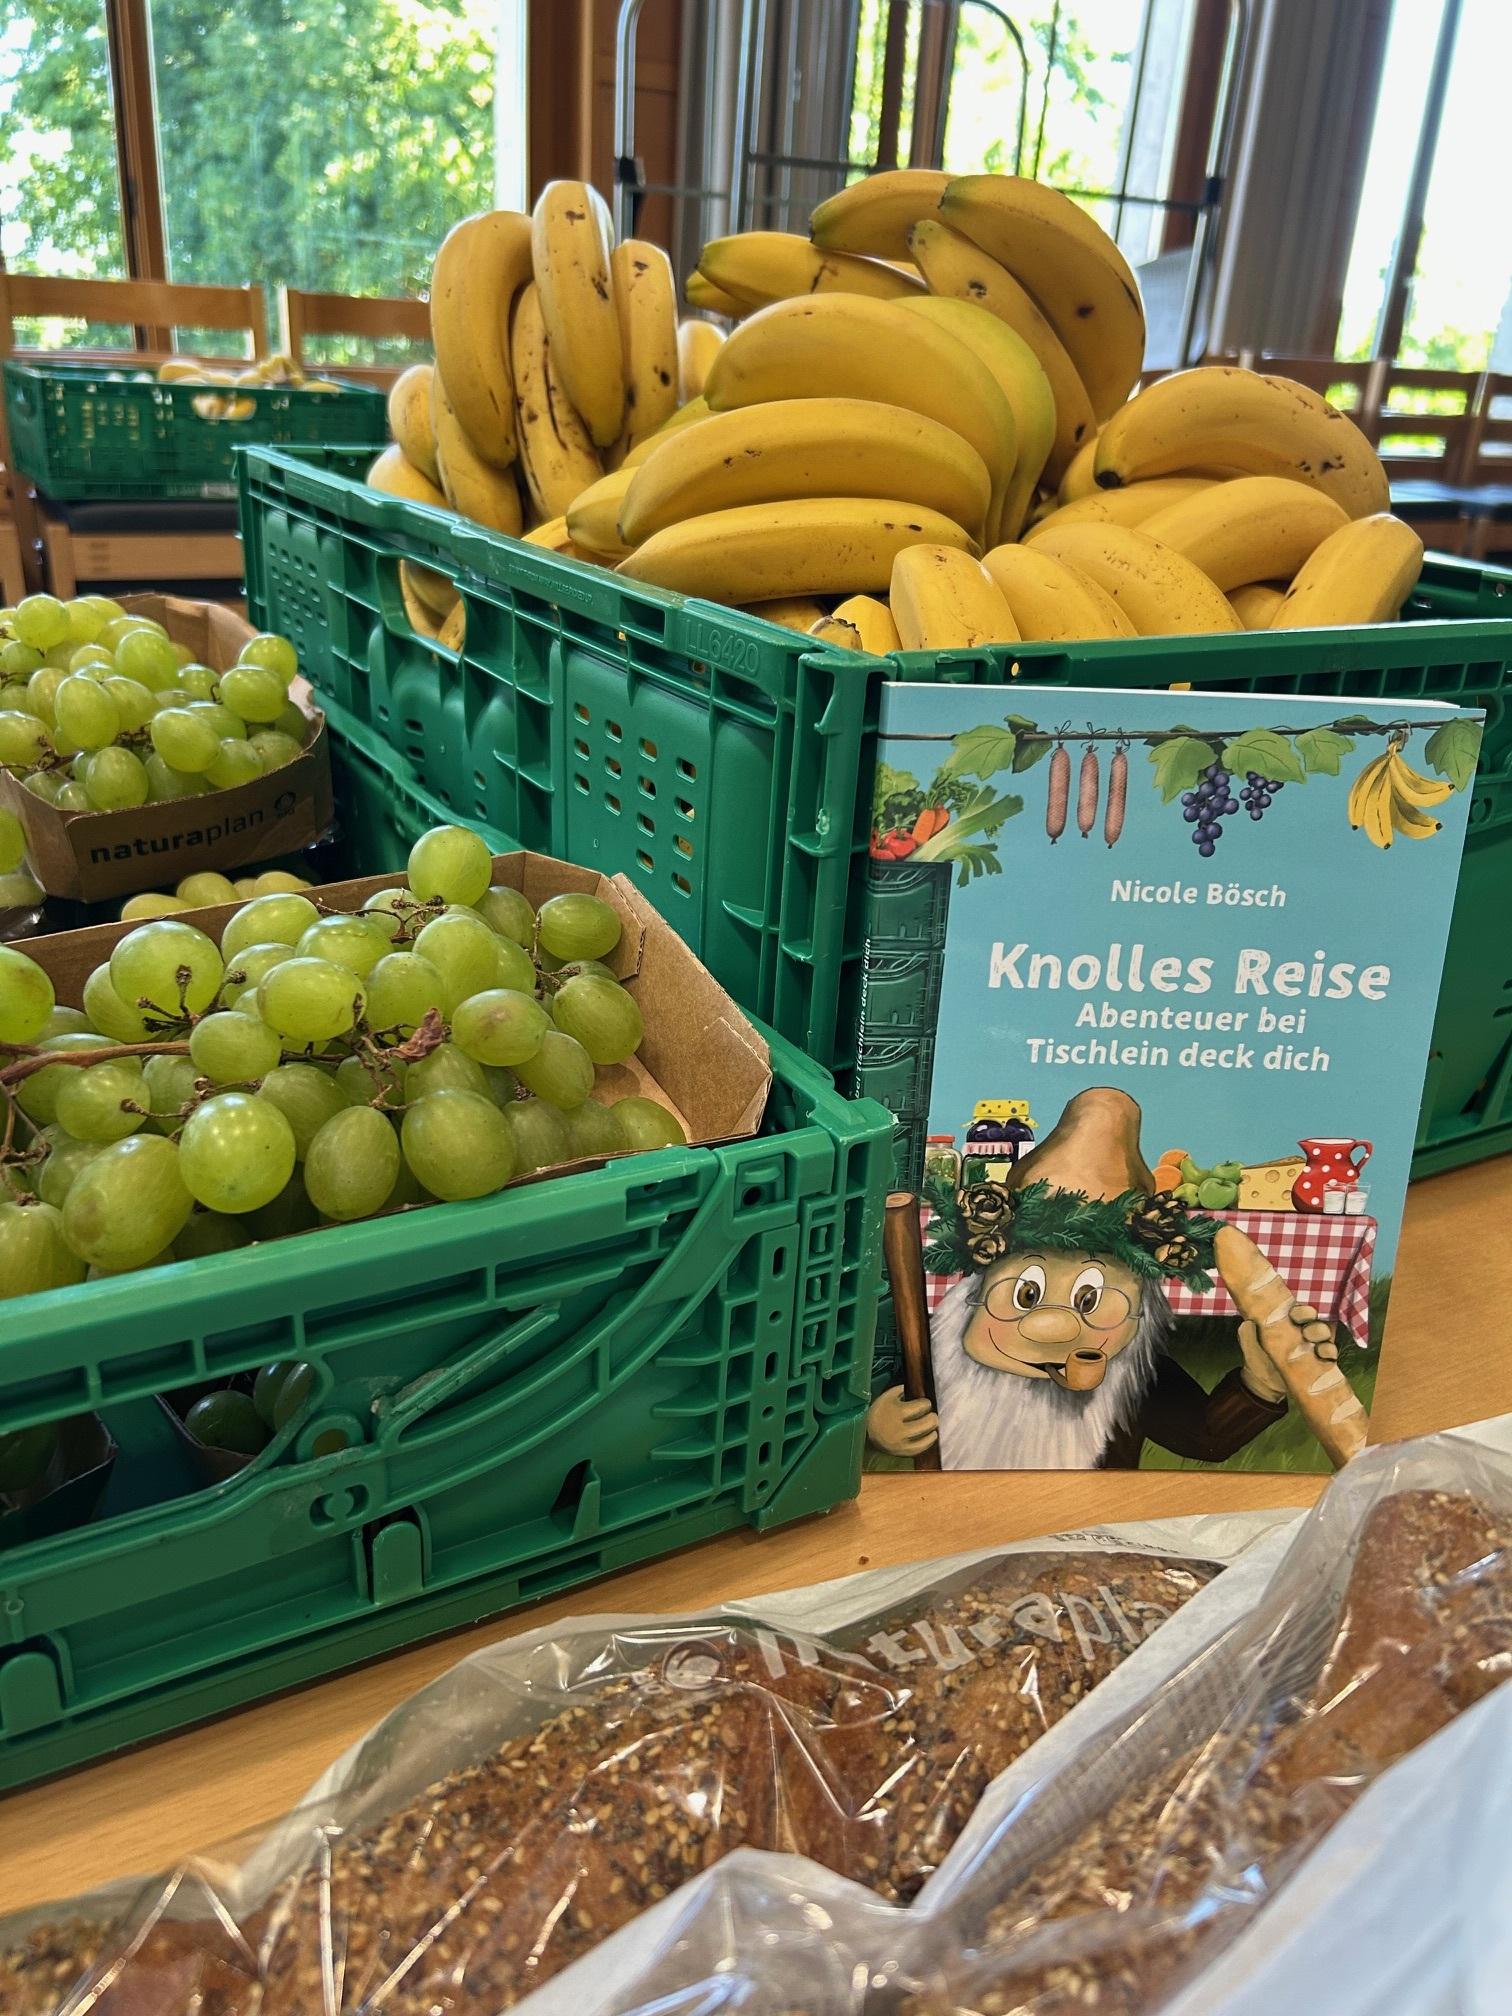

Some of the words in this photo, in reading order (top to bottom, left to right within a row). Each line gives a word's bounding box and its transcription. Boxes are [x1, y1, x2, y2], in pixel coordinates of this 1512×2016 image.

[685, 618, 761, 674] LL6420
[90, 809, 264, 864] naturaplan
[1110, 879, 1199, 905] Nicole
[1205, 882, 1287, 908] Bösch
[863, 938, 872, 970] dich
[987, 940, 1216, 994] Knolles
[1234, 948, 1391, 1001] Reise
[861, 972, 869, 1007] deck
[1074, 1001, 1249, 1031] Abenteuer
[1257, 1005, 1307, 1034] bei
[856, 1010, 866, 1072] Tischlein
[1026, 1036, 1169, 1067] Tischlein
[1178, 1042, 1256, 1070] deck
[1263, 1045, 1331, 1072] dich
[854, 1075, 862, 1099] bei
